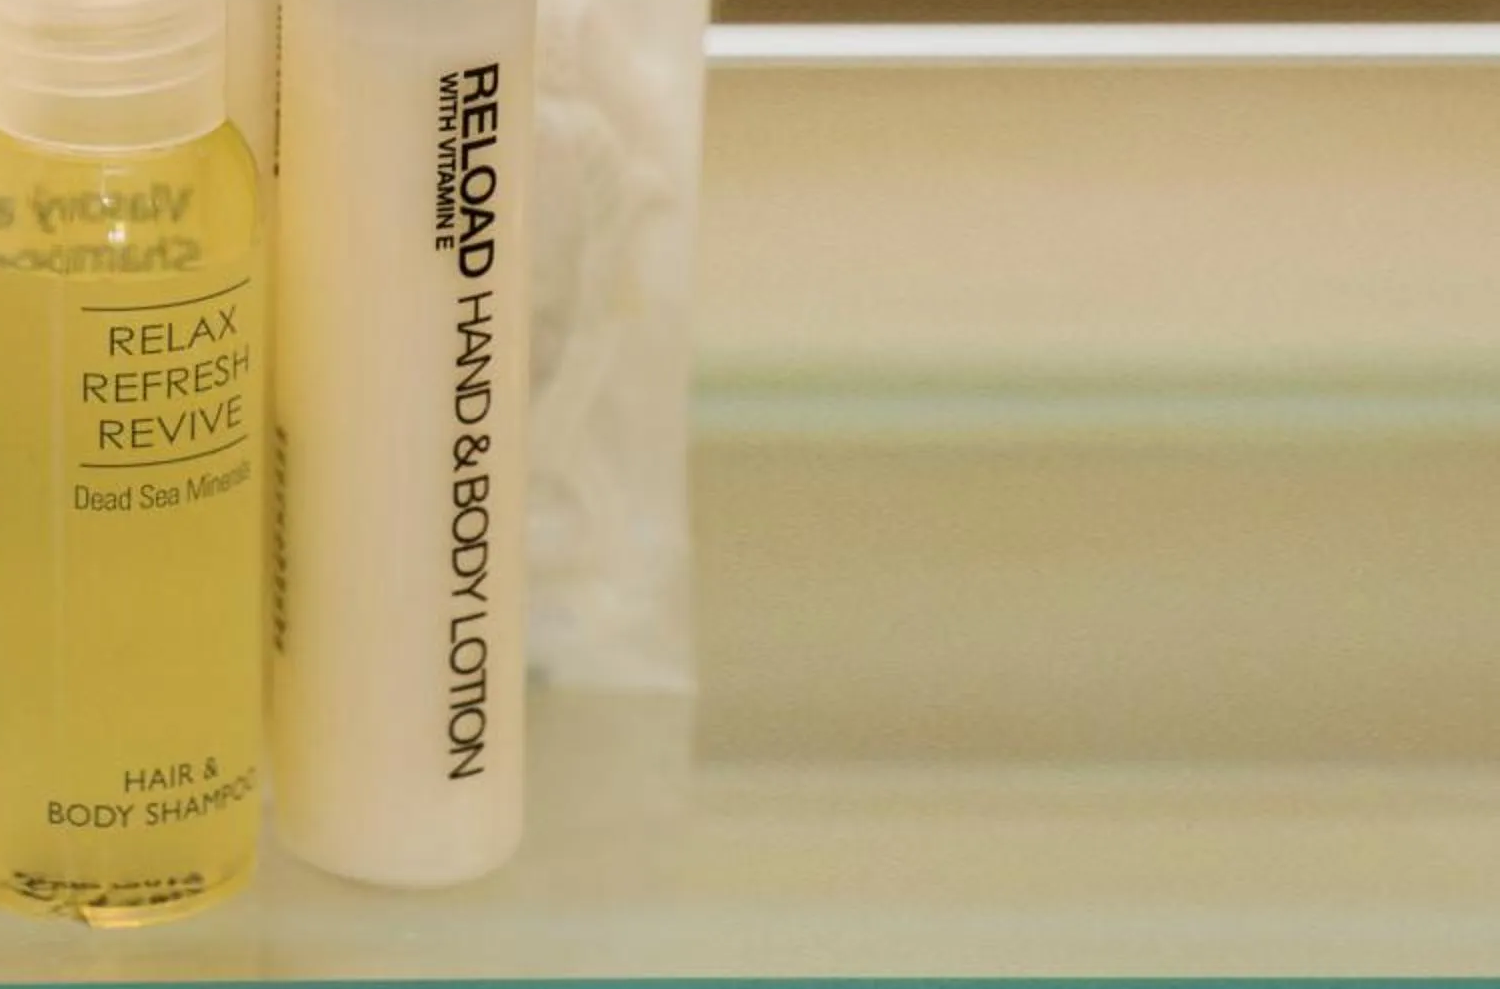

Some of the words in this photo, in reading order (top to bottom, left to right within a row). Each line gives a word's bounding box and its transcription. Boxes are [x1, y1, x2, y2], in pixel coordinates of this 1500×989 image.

[438, 72, 458, 132] WITH
[435, 137, 457, 230] VITAMIN
[458, 62, 499, 278] RELOAD
[435, 234, 455, 251] E
[109, 304, 238, 356] RELAX
[456, 291, 493, 425] HAND
[83, 343, 250, 403] REFRESH
[99, 394, 242, 450] REVIVE
[453, 434, 491, 473] &
[74, 484, 132, 512] Dead
[139, 483, 180, 510] Sea
[451, 474, 490, 602] BODY
[448, 611, 488, 781] LOTION
[124, 763, 194, 793] HAIR
[203, 756, 219, 781] &
[47, 801, 135, 828] BODY
